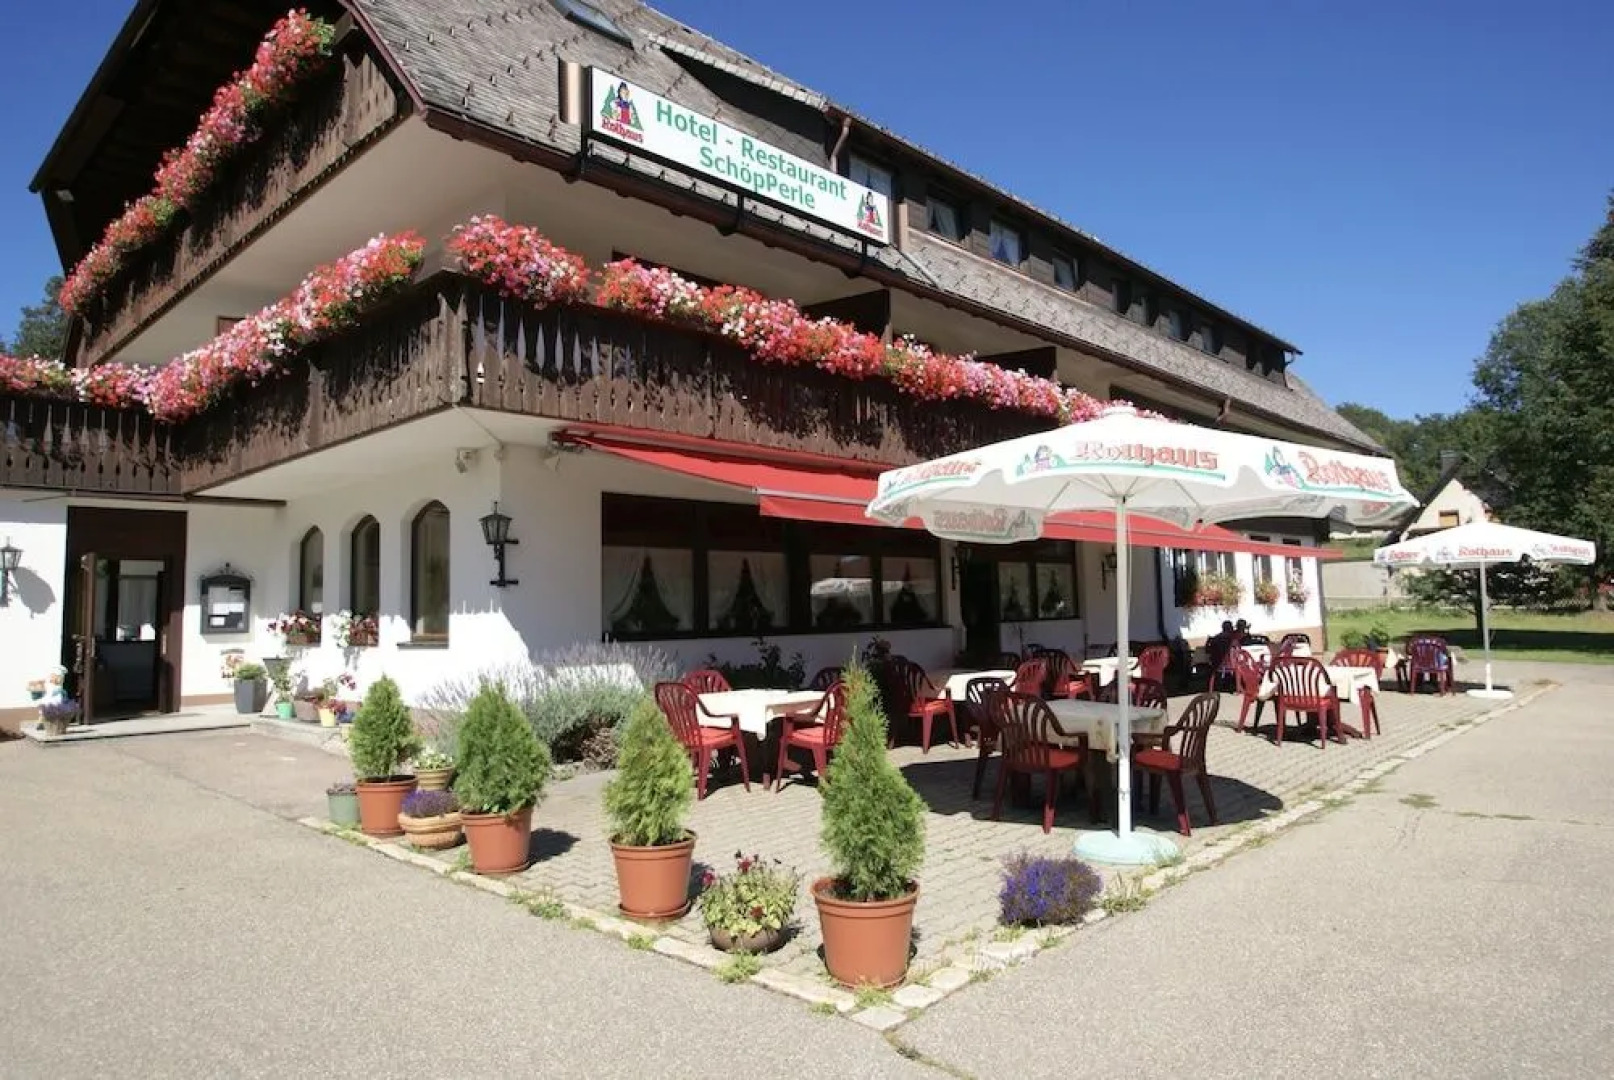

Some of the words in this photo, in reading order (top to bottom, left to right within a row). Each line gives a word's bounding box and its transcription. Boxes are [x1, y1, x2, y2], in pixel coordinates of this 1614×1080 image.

[656, 100, 717, 145] Hotel
[742, 137, 847, 201] Restaurant
[700, 146, 816, 210] SchöpPerle
[1070, 441, 1219, 470] Rothaus
[1458, 546, 1513, 558] Rothaus
